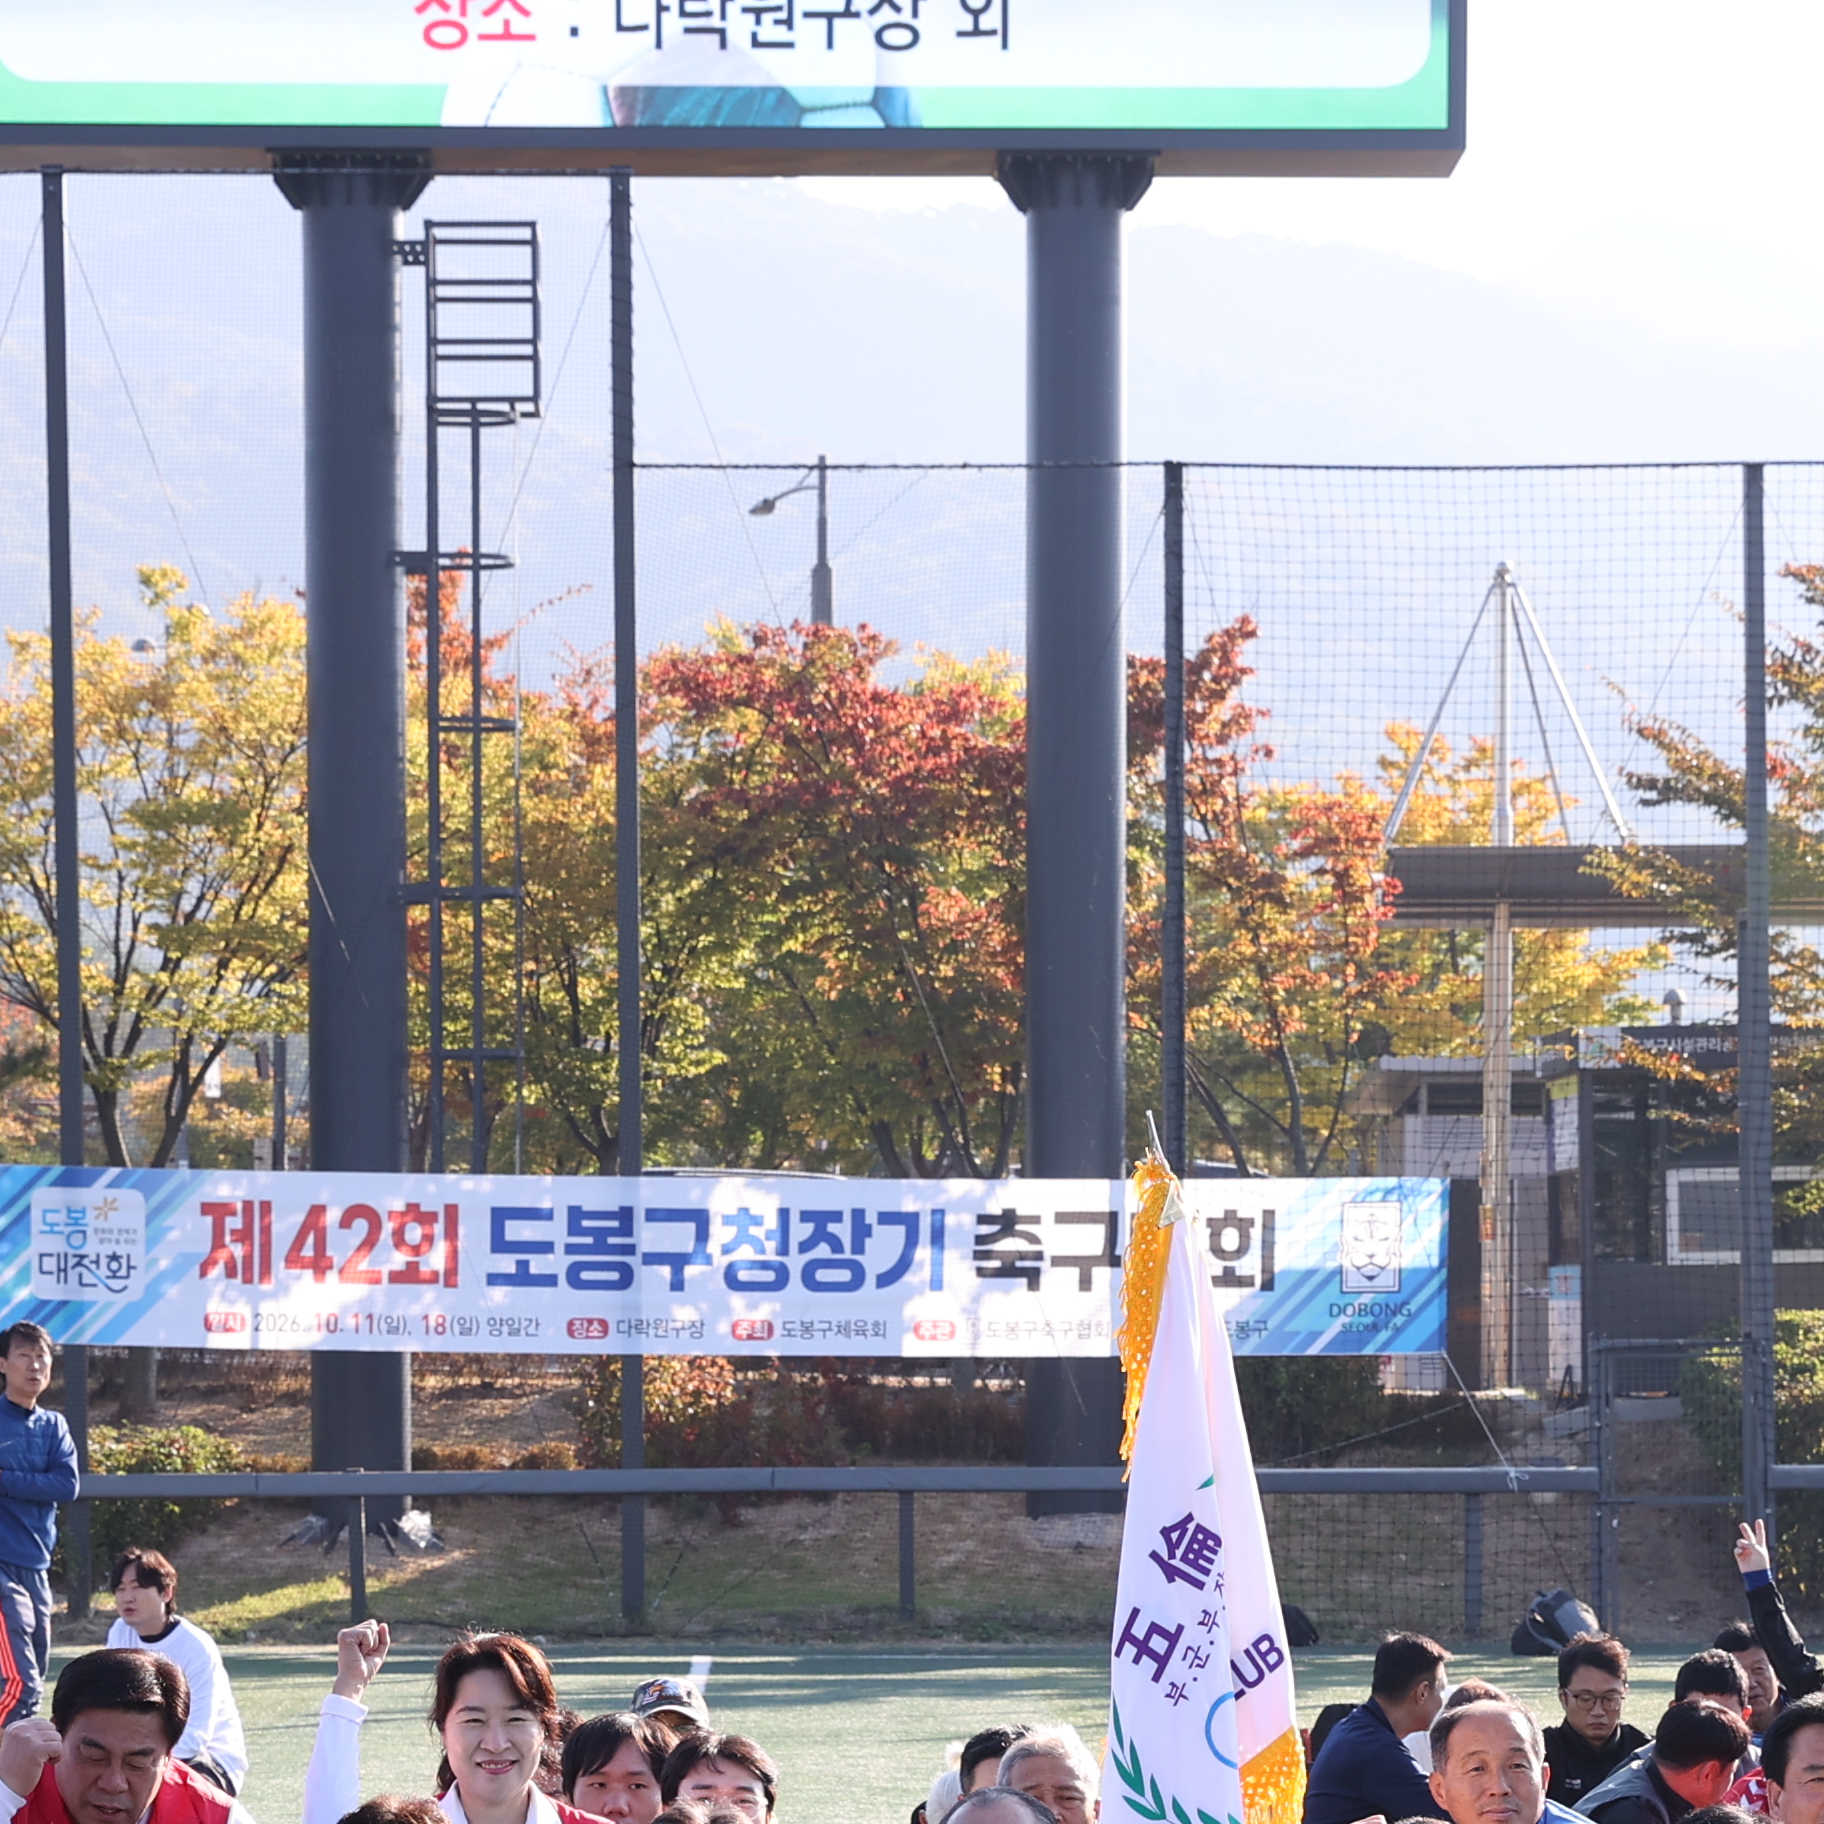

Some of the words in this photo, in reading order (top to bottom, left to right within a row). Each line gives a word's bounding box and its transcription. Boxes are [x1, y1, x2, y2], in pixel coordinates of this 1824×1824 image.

[38, 1205, 89, 1250] 도봉
[199, 1199, 459, 1289] 제42회
[485, 1206, 946, 1293] 도봉구청장기
[975, 1206, 1275, 1293] 축구회
[38, 1250, 137, 1294] 대전환
[486, 1316, 541, 1338] 양일간
[572, 1319, 605, 1339] 장소
[616, 1318, 706, 1339] 다락원구장
[734, 1320, 769, 1340] 주최
[780, 1319, 887, 1340] 도봉구체육회
[918, 1321, 953, 1340] 주관
[986, 1319, 1111, 1341] 도봉구축구협회
[1328, 1303, 1412, 1318] DOBONG
